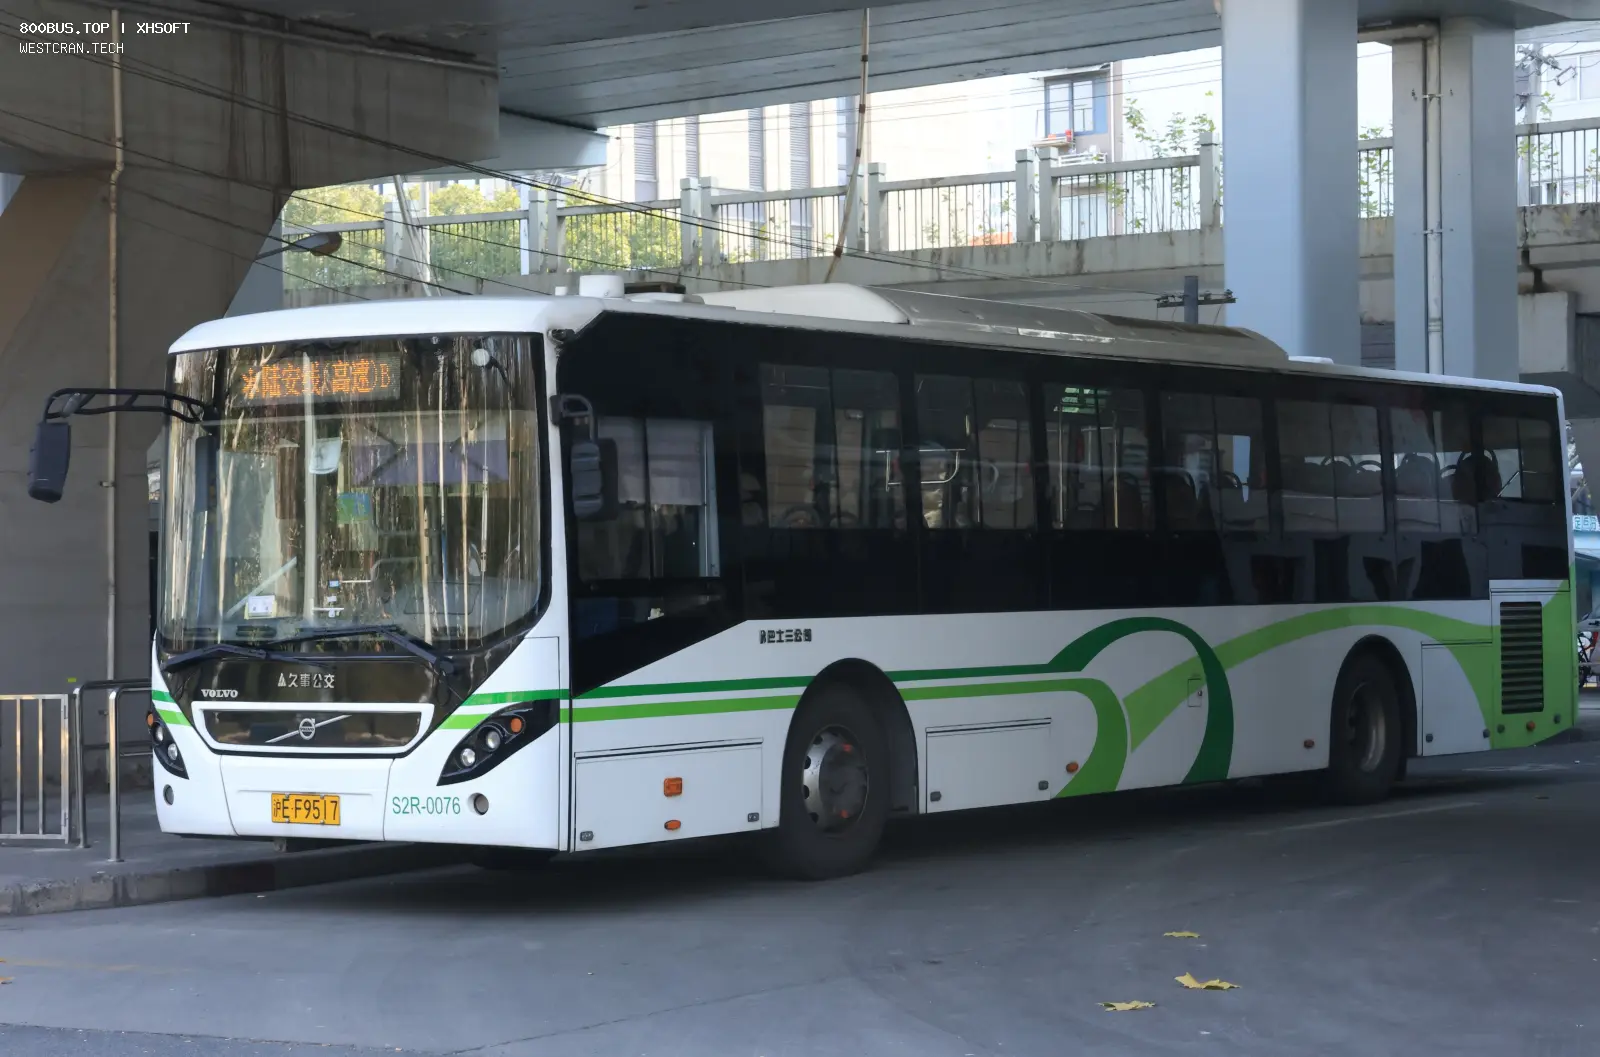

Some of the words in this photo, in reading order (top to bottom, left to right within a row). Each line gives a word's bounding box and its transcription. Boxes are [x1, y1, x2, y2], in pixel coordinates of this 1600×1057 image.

[288, 672, 335, 688] 久事公交
[201, 689, 238, 697] VOLVO
[392, 796, 461, 815] S2R-0076
